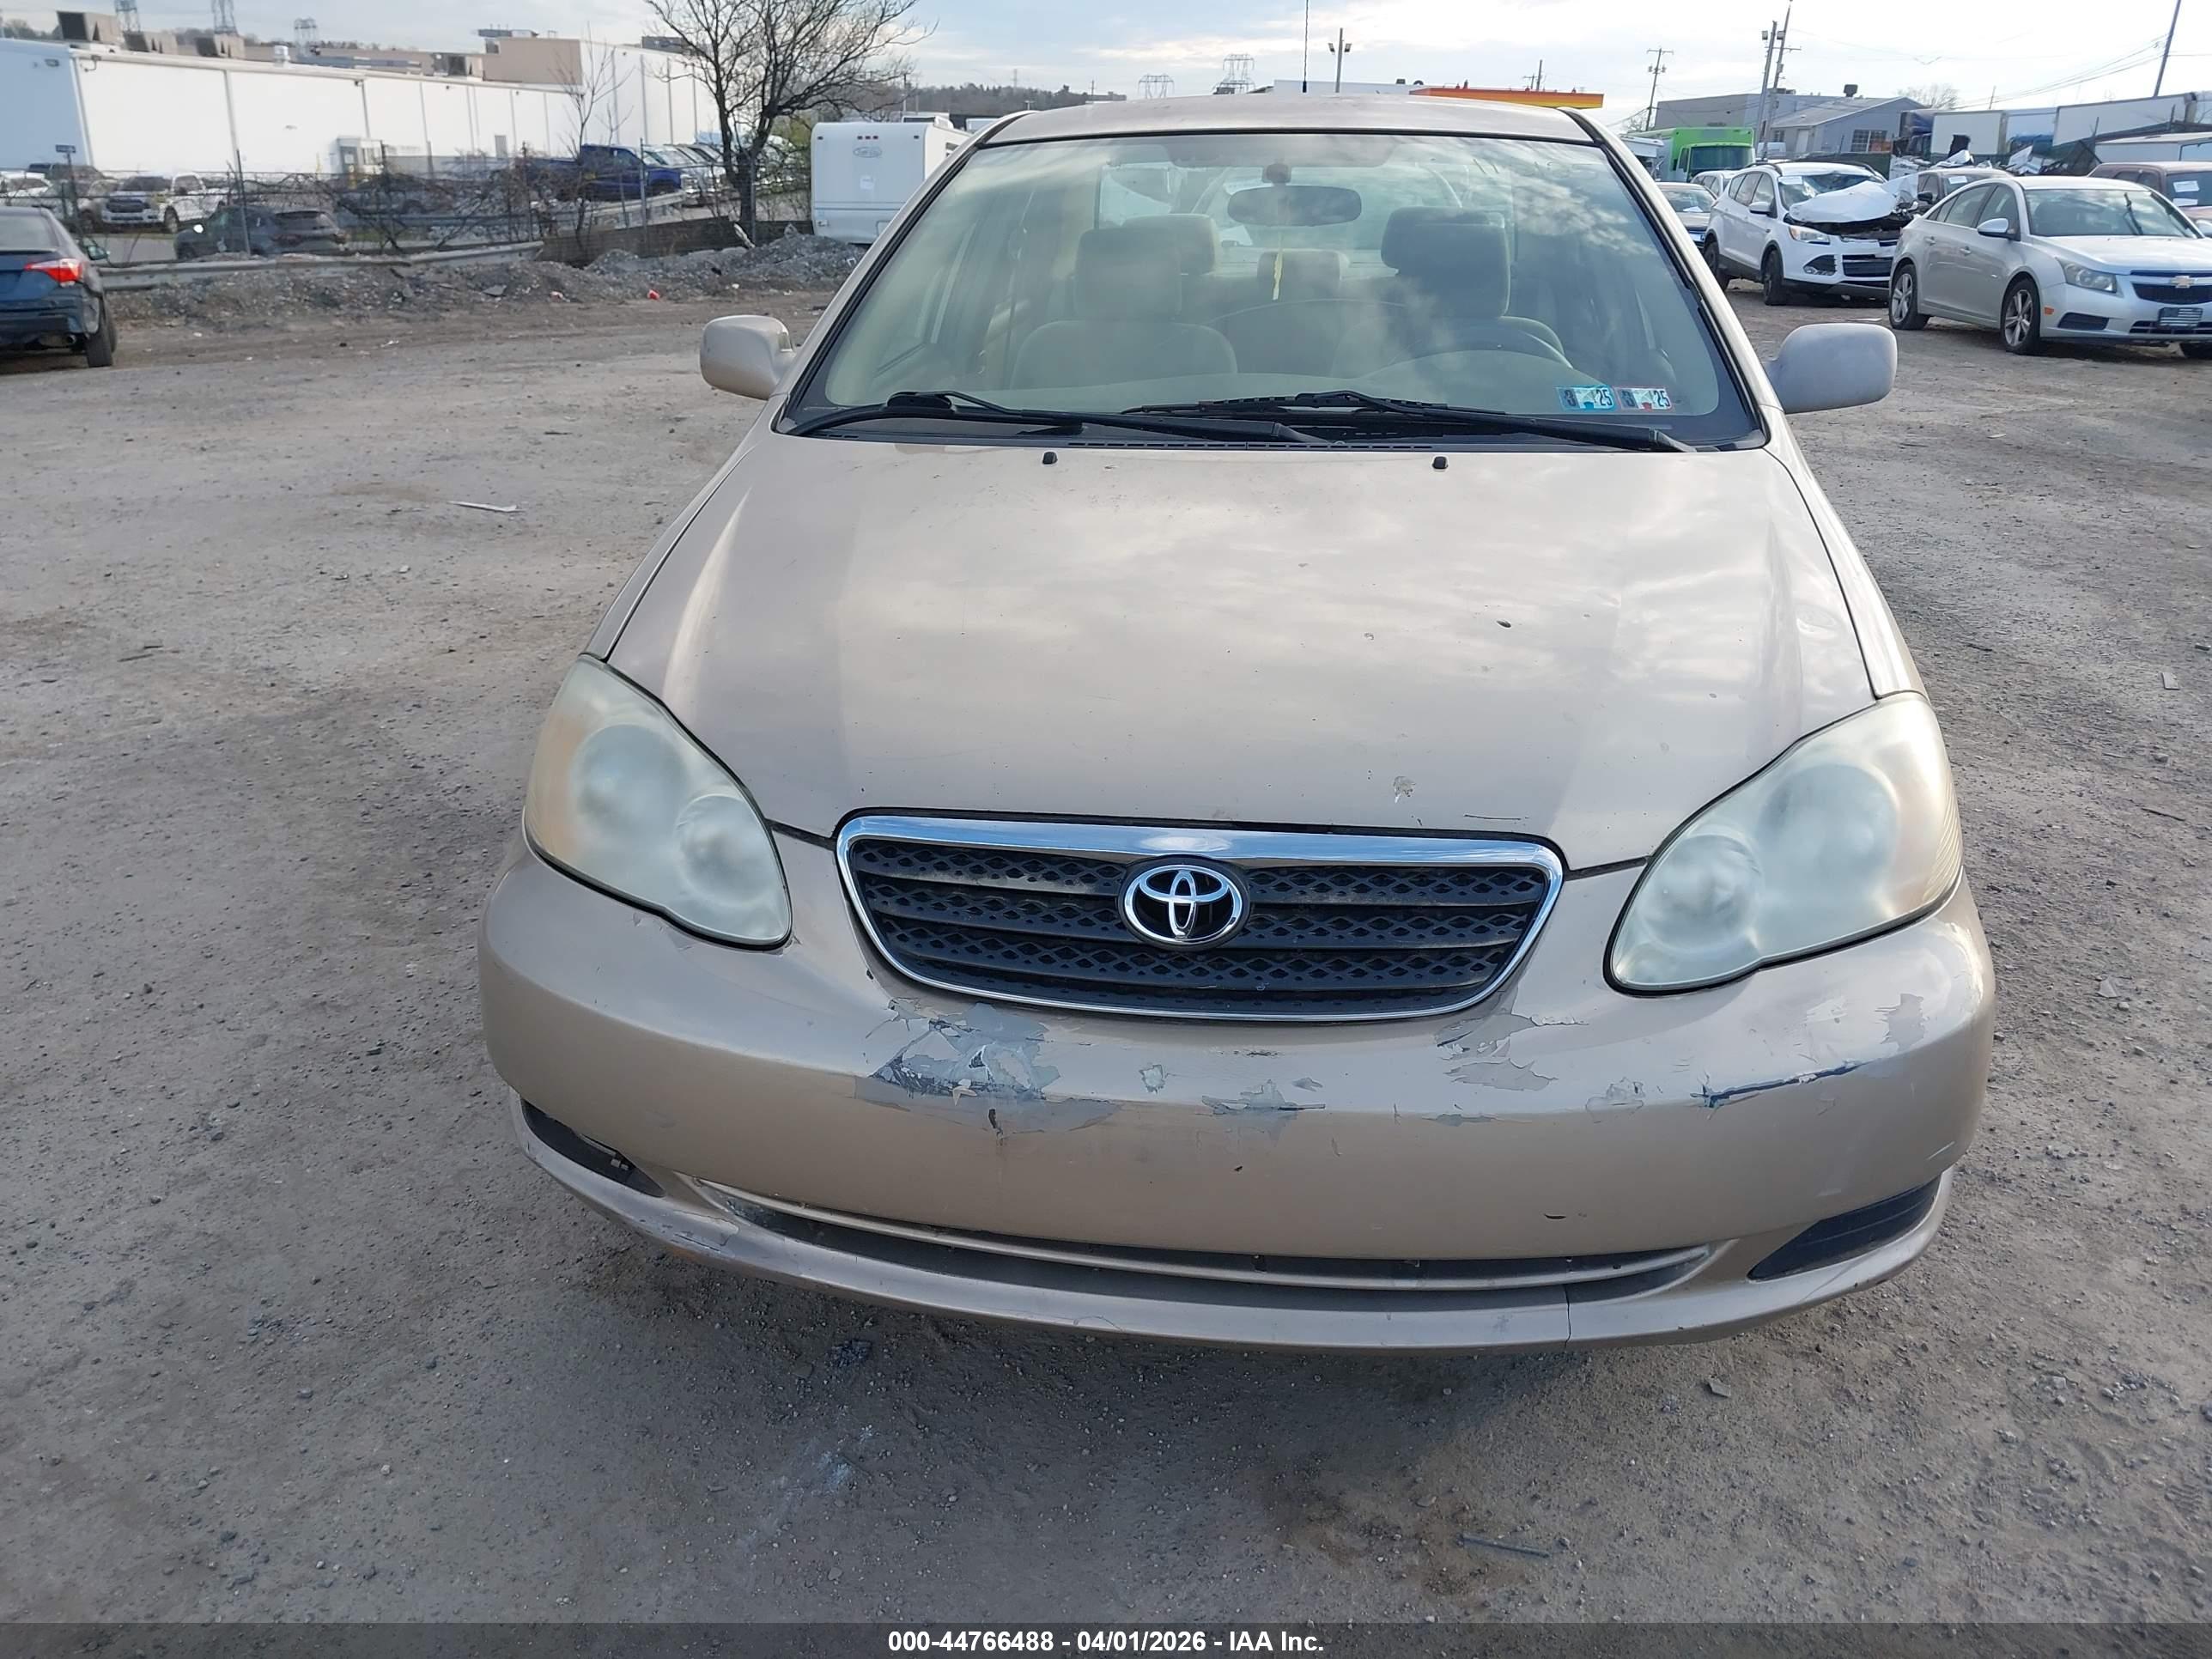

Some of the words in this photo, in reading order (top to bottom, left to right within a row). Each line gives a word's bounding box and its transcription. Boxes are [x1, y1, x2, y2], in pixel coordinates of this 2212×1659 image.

[1565, 390, 1577, 408] 3
[1595, 389, 1613, 407] 25
[1653, 390, 1671, 408] 25
